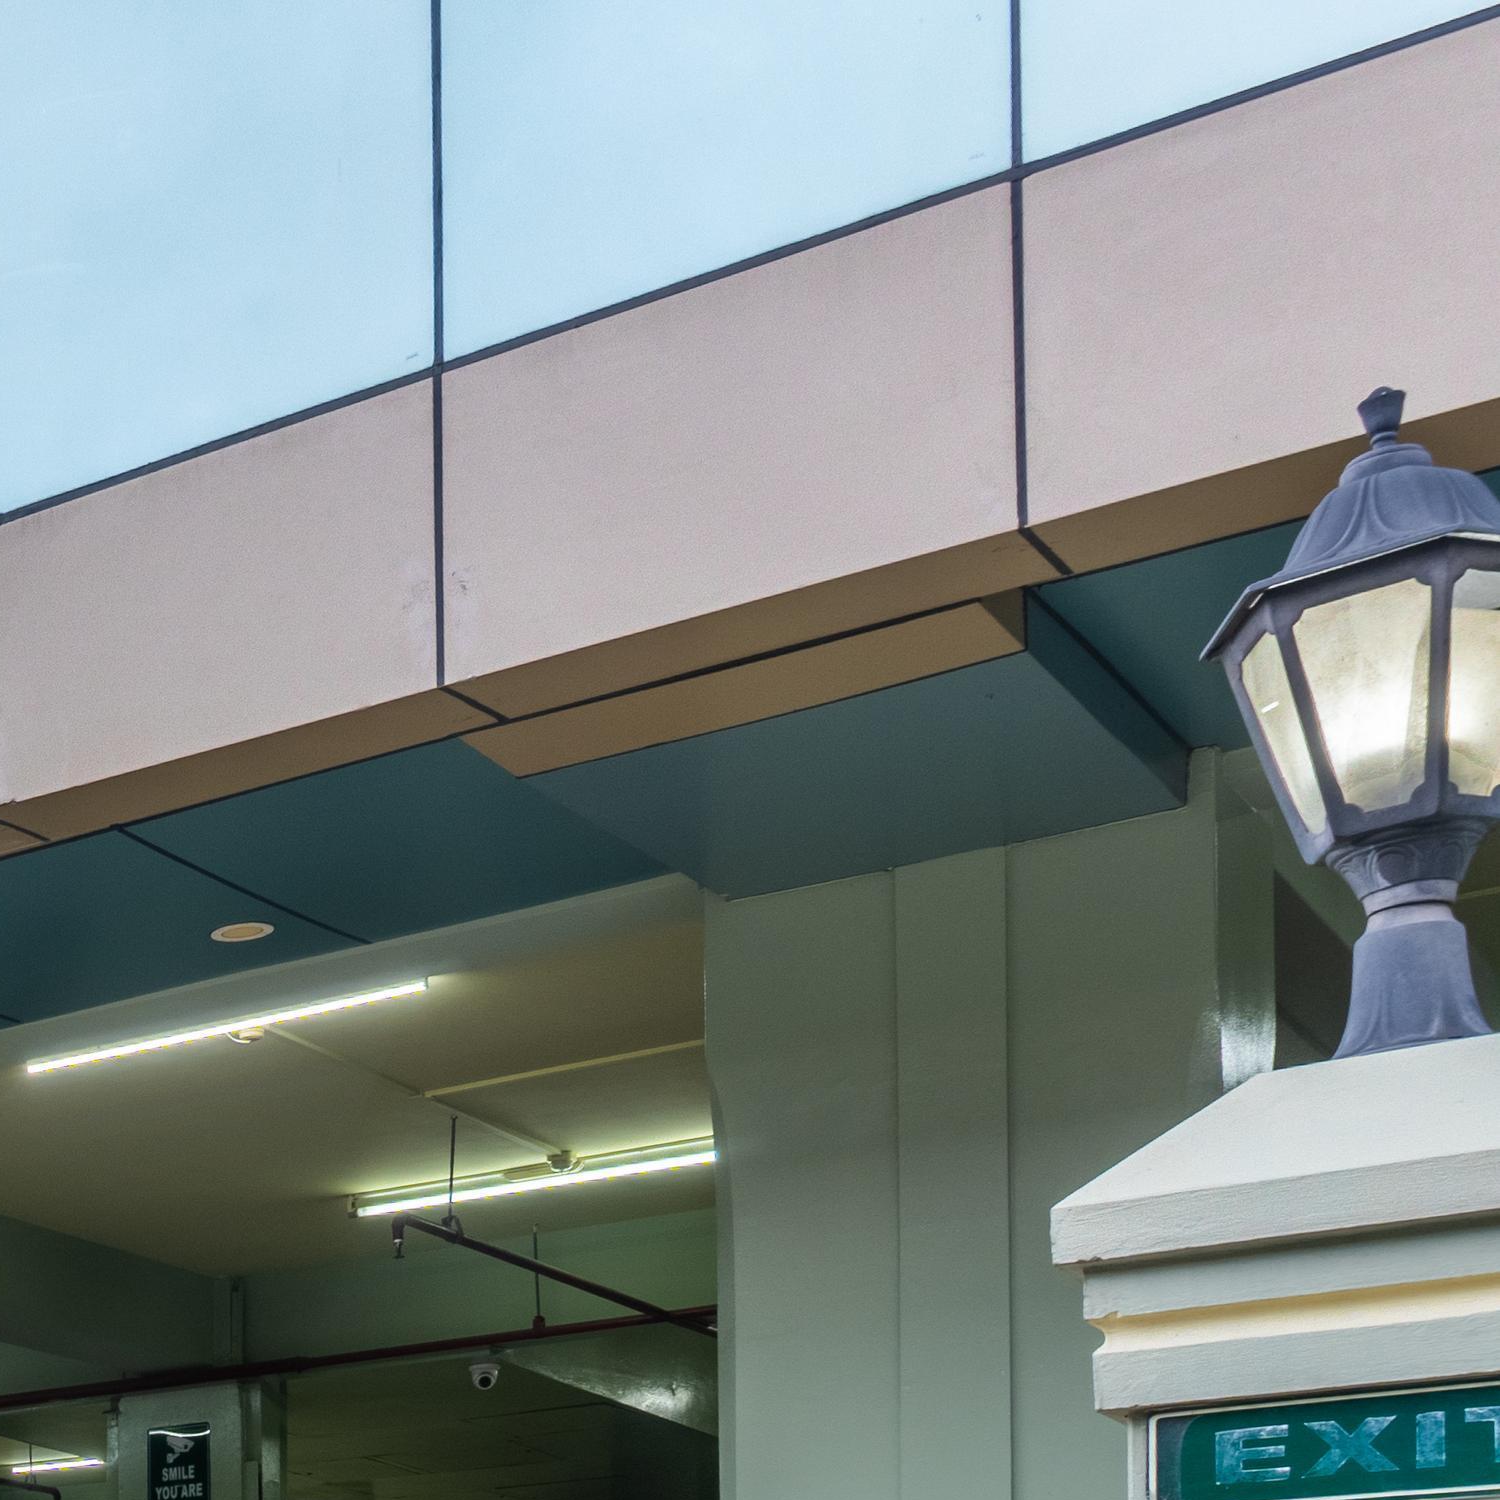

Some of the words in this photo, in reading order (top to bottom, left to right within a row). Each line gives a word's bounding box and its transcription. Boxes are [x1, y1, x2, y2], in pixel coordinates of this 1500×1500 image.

[162, 1465, 195, 1482] SMILE
[155, 1485, 178, 1500] YOU
[180, 1483, 204, 1498] ARE
